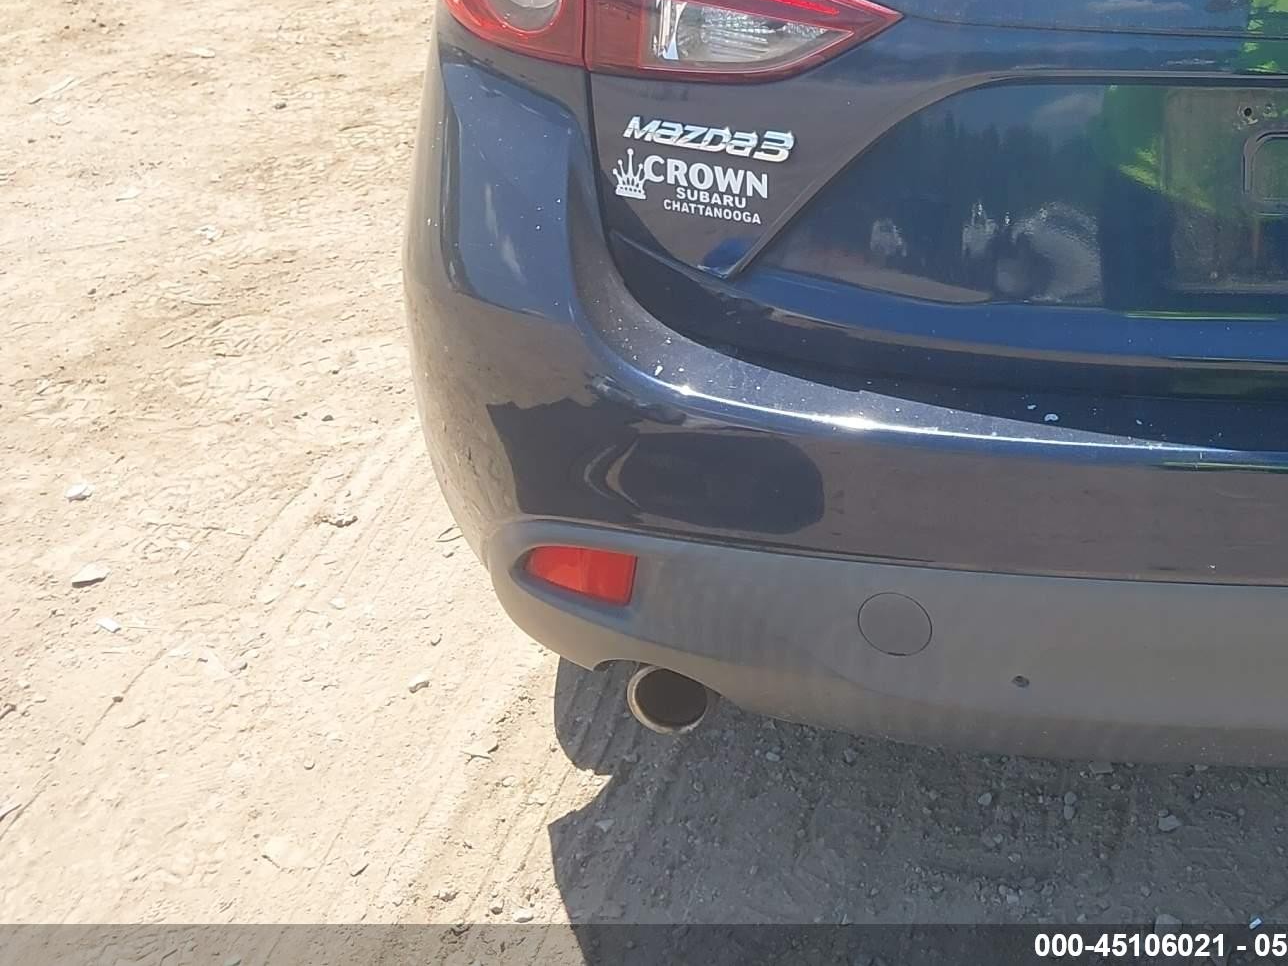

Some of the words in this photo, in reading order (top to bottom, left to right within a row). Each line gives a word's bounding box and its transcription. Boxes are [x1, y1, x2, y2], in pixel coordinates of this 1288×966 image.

[643, 154, 769, 199] CROWN
[676, 186, 747, 209] SUBARU
[663, 199, 762, 225] CHATTANOOGA
